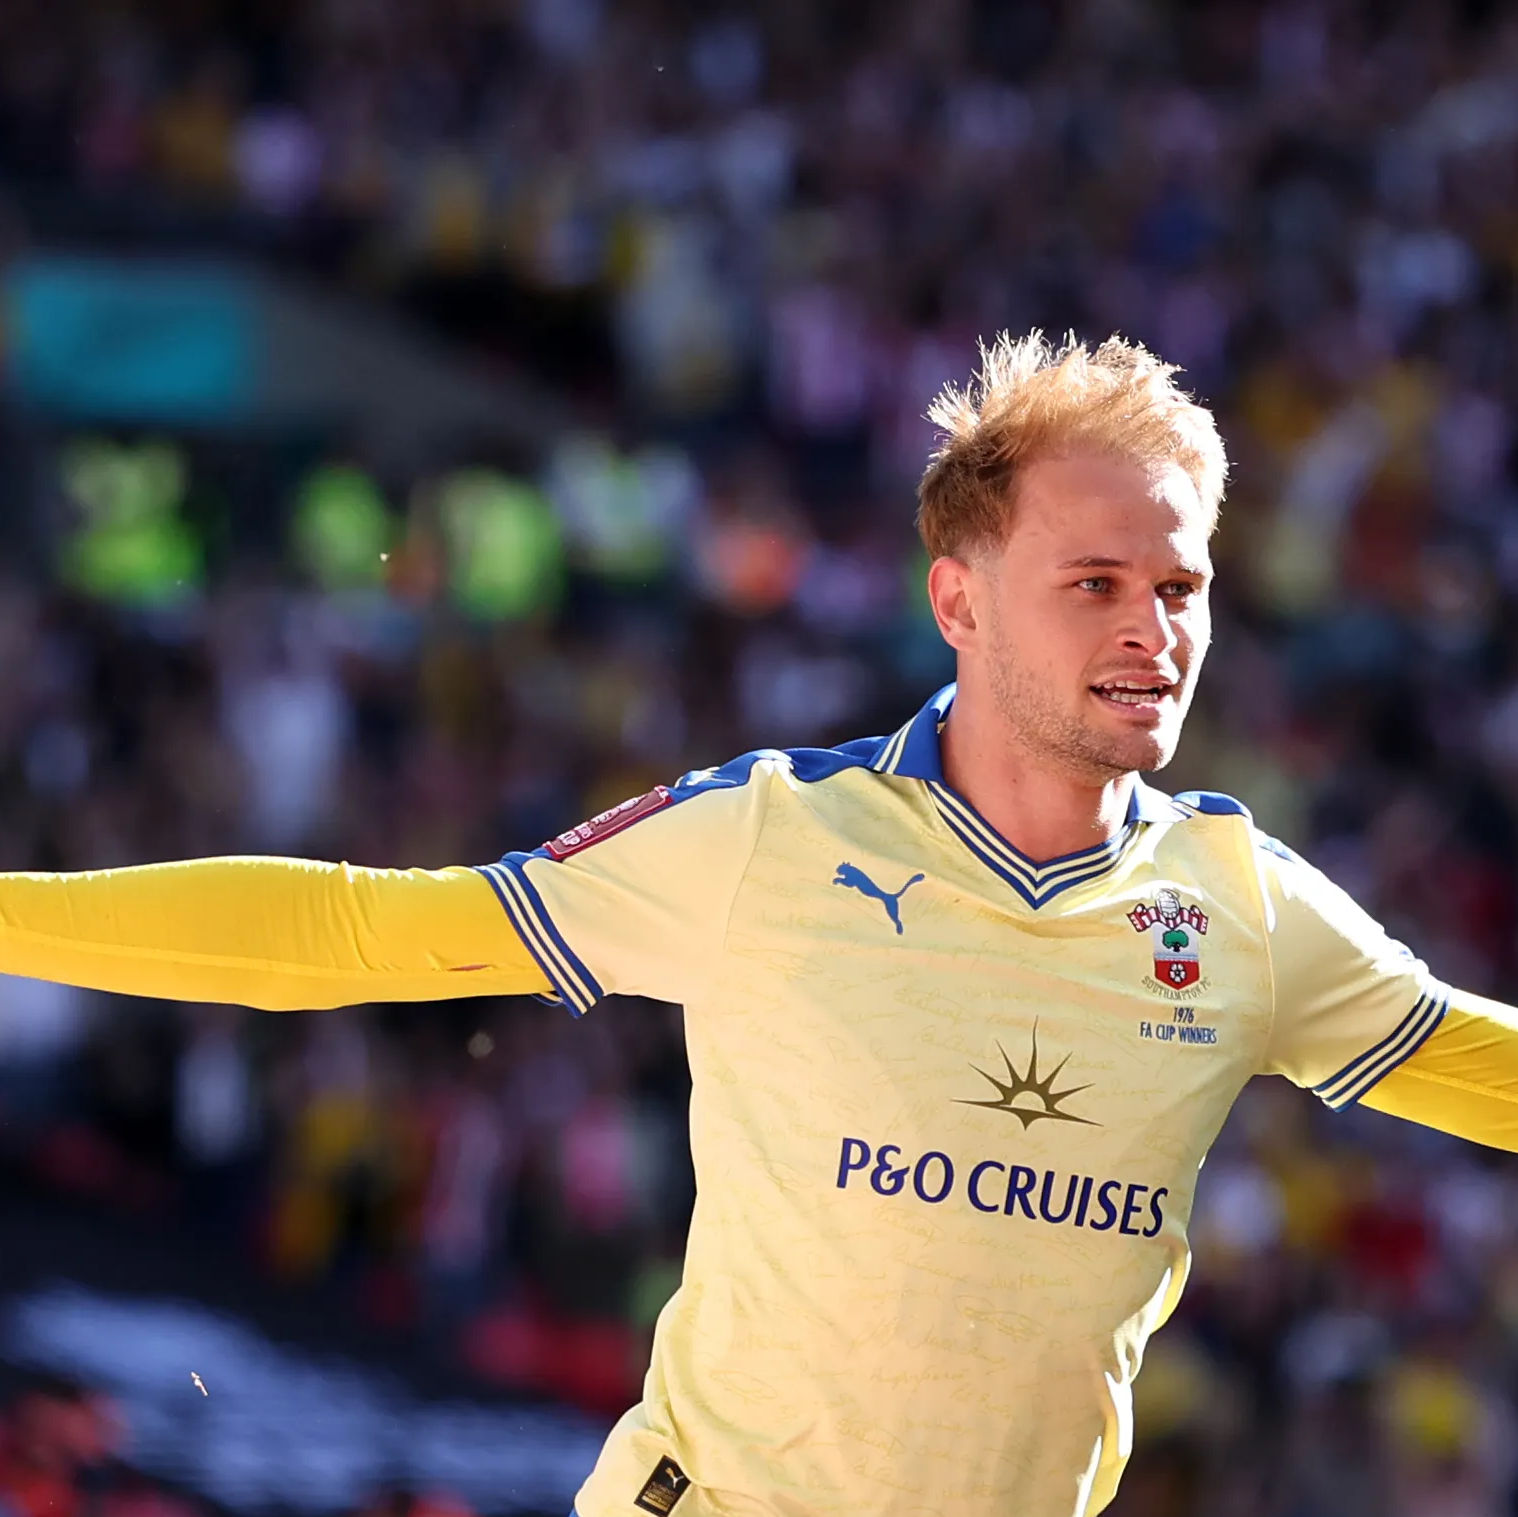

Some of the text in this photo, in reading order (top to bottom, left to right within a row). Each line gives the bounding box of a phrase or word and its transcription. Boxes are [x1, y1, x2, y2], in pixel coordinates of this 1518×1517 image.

[1141, 975, 1202, 1001] SOUTHAMPTON
[1173, 1007, 1195, 1024] 1976
[1140, 1021, 1217, 1044] FA CUP WINNERS
[836, 1137, 1169, 1239] P&O CRUISES
